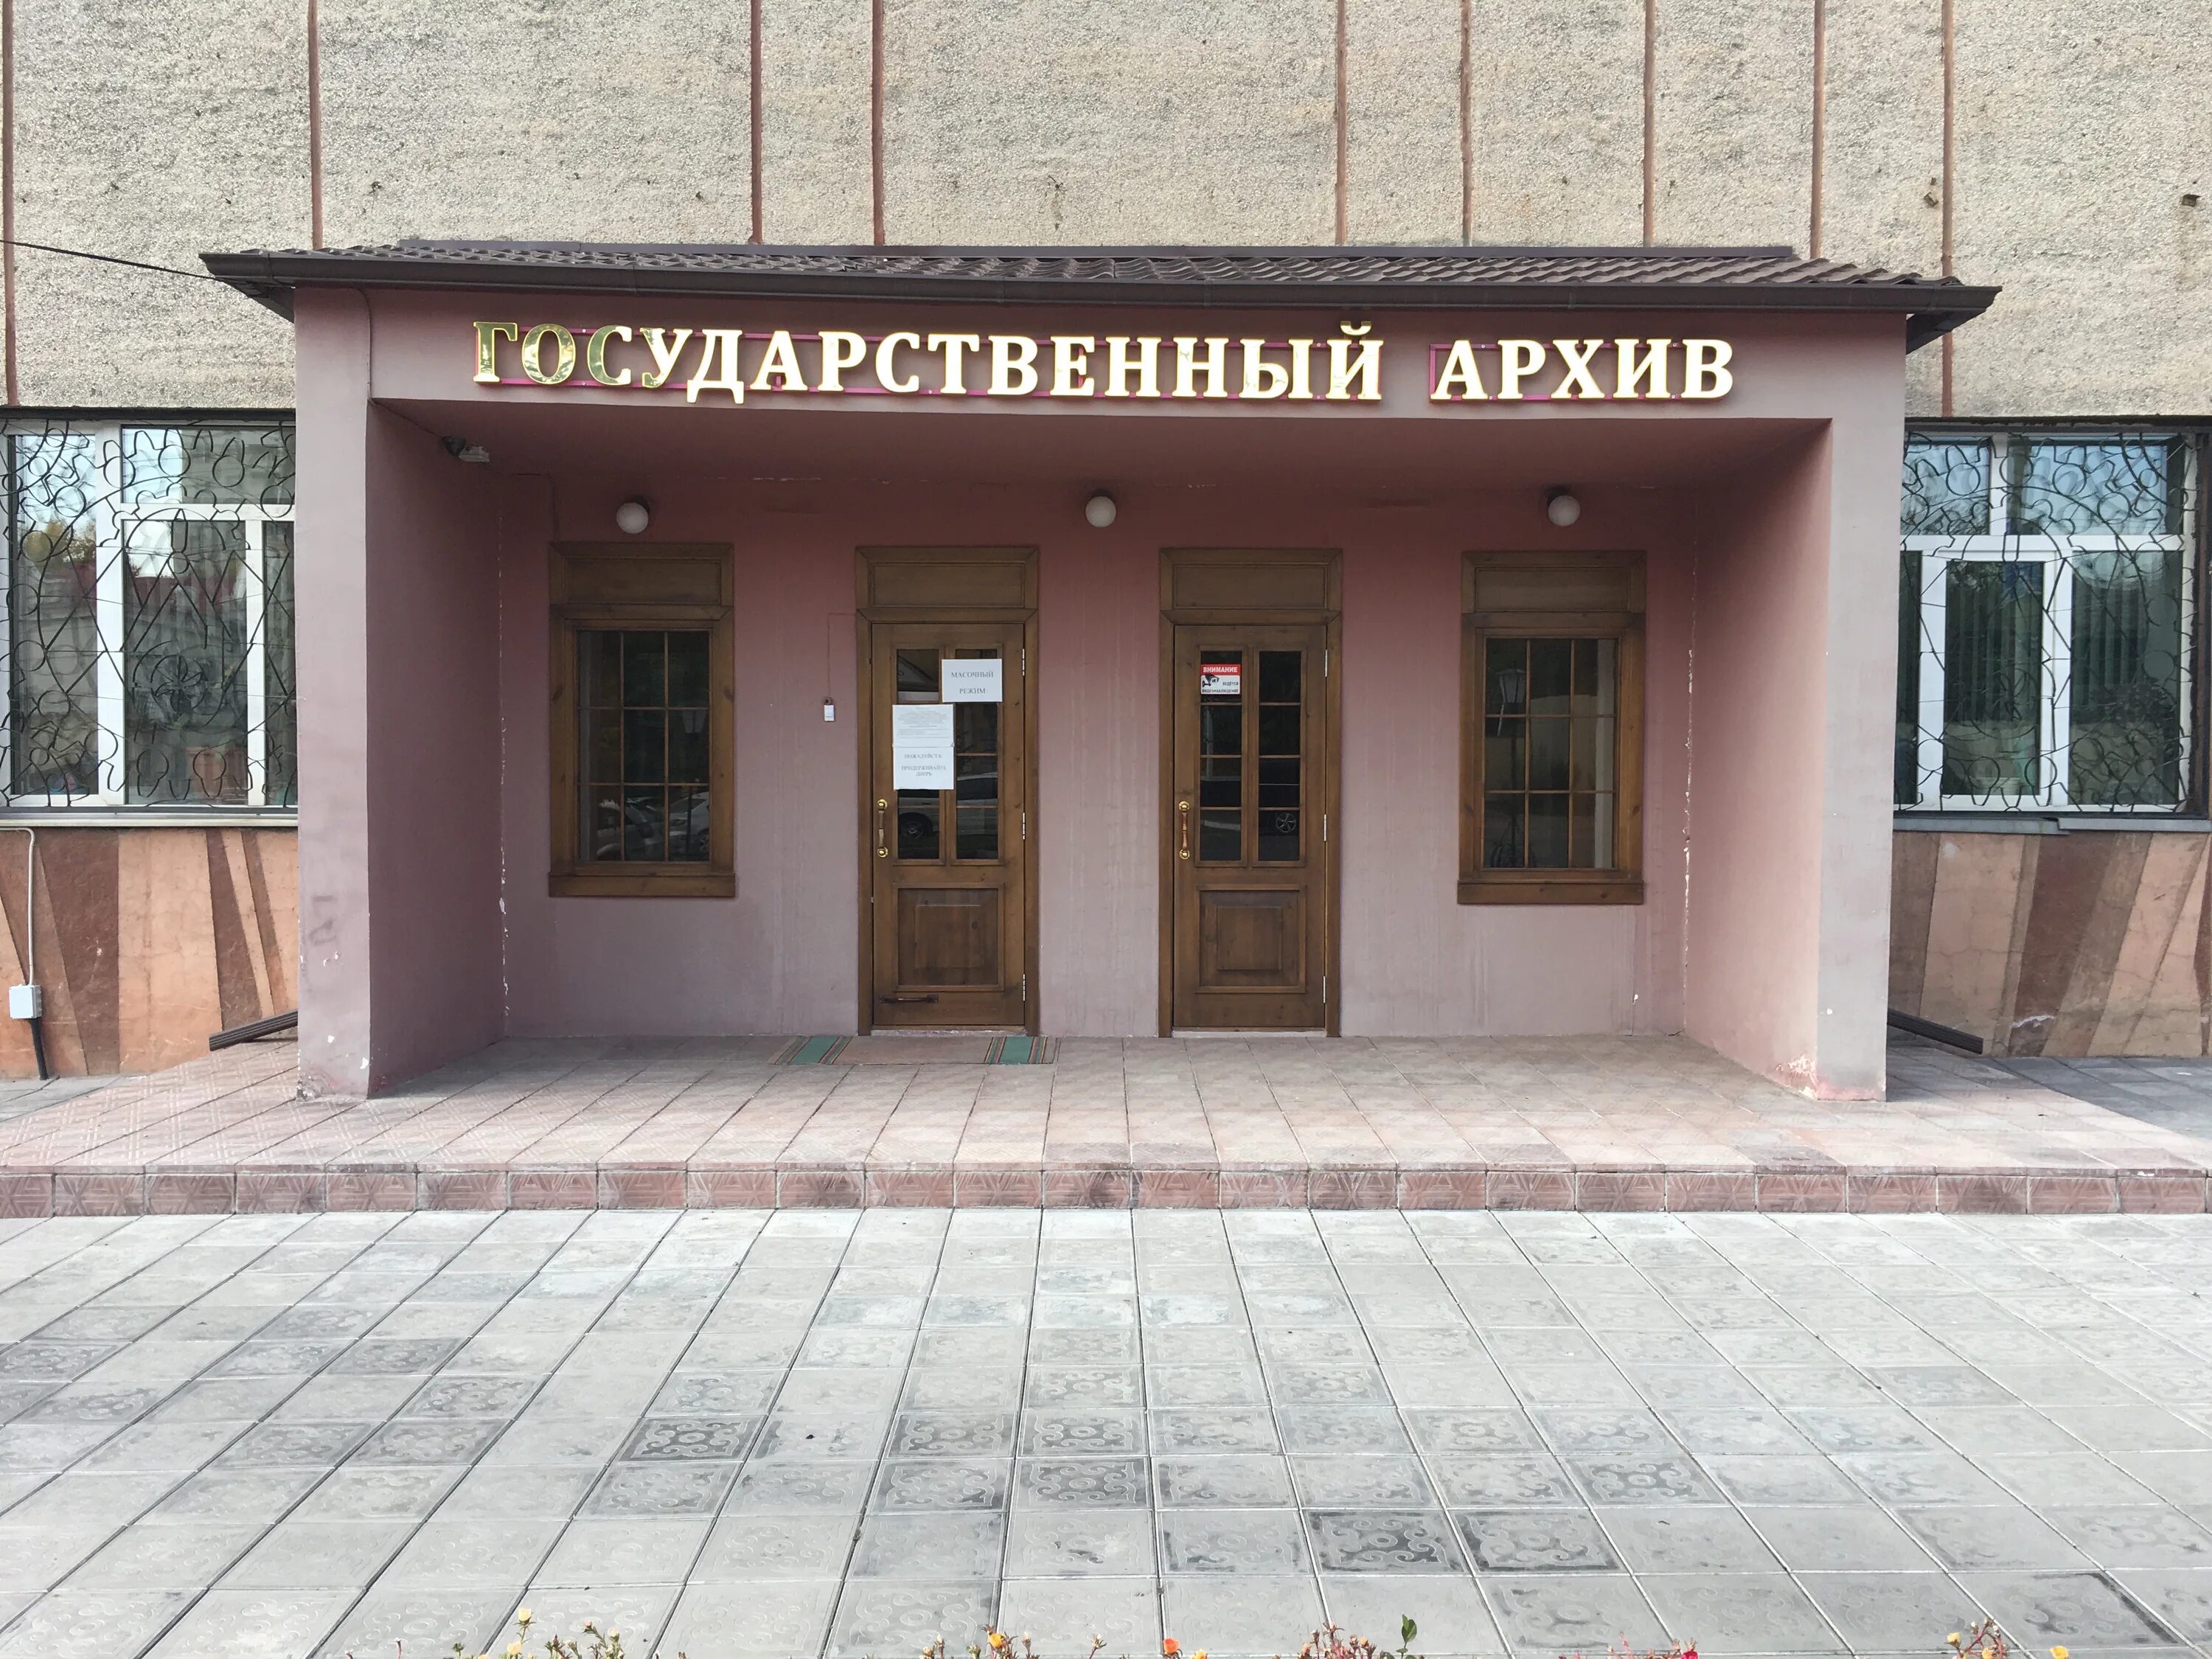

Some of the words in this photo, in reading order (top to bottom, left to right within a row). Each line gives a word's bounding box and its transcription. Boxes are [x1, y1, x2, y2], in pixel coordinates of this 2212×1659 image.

[473, 320, 1382, 404] ГОСУДАРСТВЕННЫЙ
[1430, 338, 1735, 401] АРХИВ
[951, 670, 994, 678] МАСОЧНЫЙ
